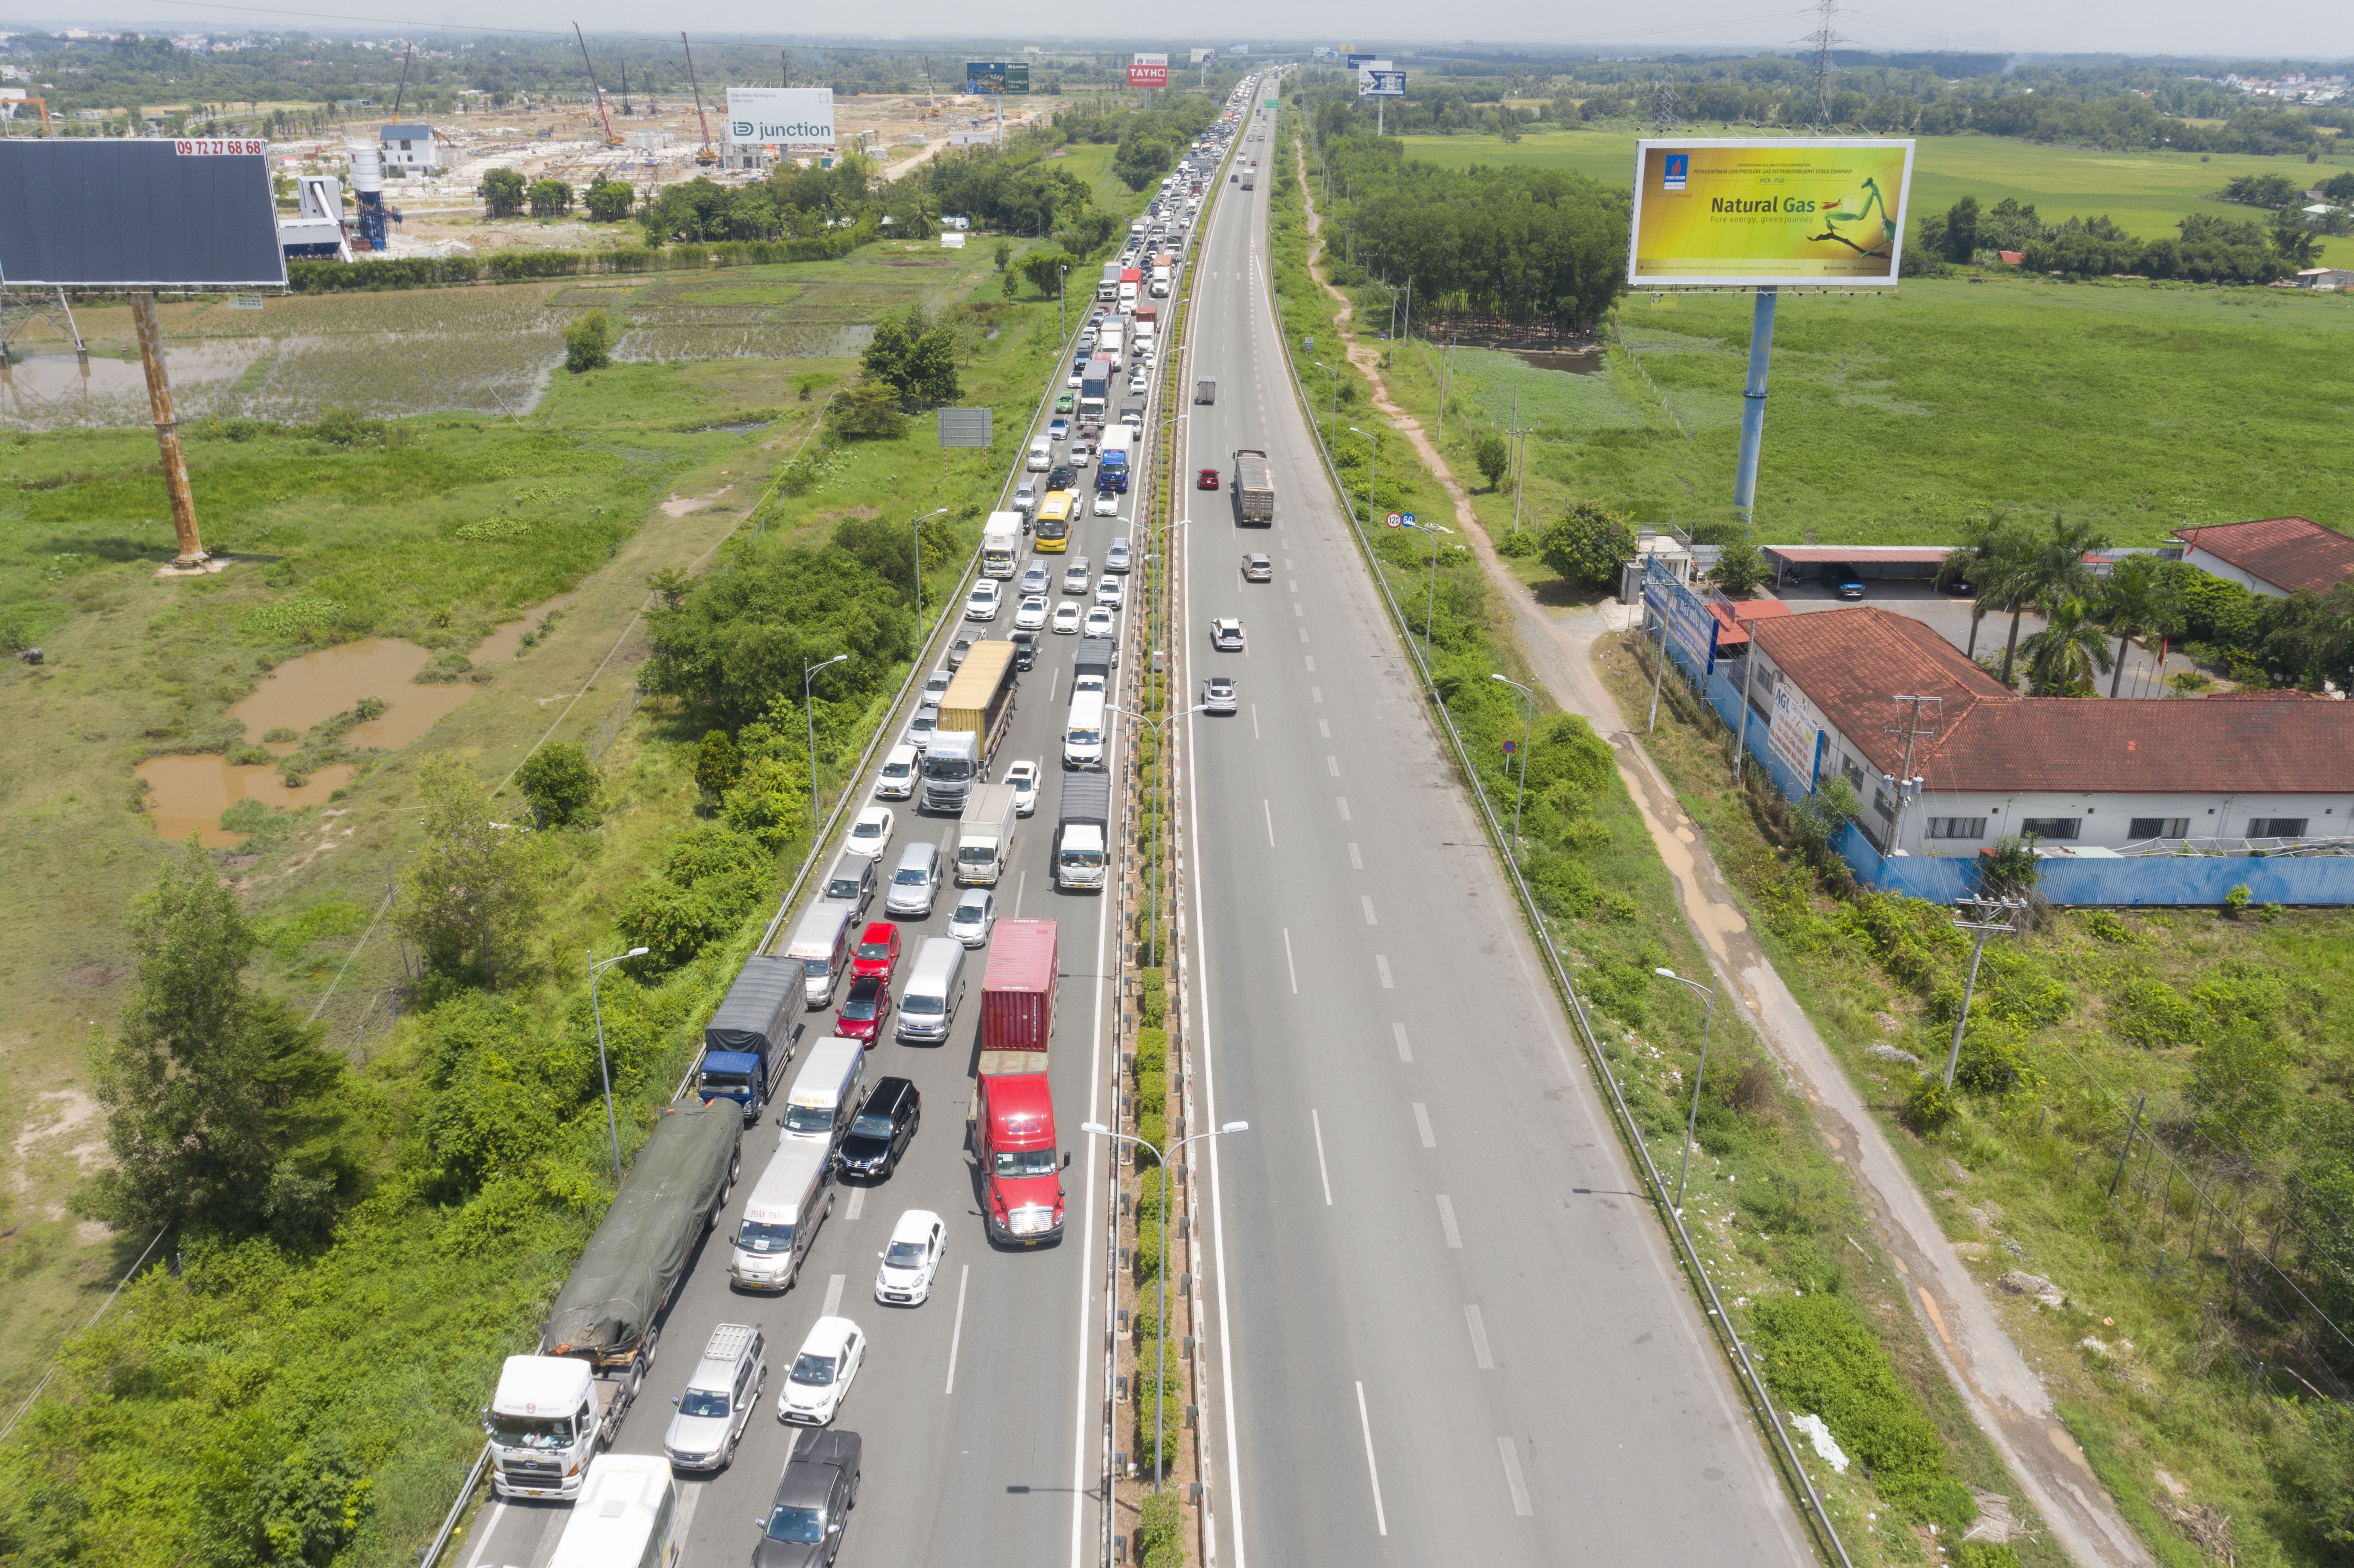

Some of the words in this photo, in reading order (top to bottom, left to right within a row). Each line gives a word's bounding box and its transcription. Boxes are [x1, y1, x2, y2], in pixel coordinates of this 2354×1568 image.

[759, 121, 830, 140] junction
[177, 141, 192, 154] 09
[196, 141, 209, 154] 72
[212, 141, 223, 154] 27
[227, 141, 243, 154] 68
[246, 141, 261, 154] 68
[1711, 196, 1778, 213] Natural
[1783, 197, 1815, 213] Gas
[1784, 216, 1814, 224] journey
[1775, 688, 1789, 714] AGL
[1021, 1121, 1040, 1129] PPL
[751, 1209, 766, 1218] TOÀN
